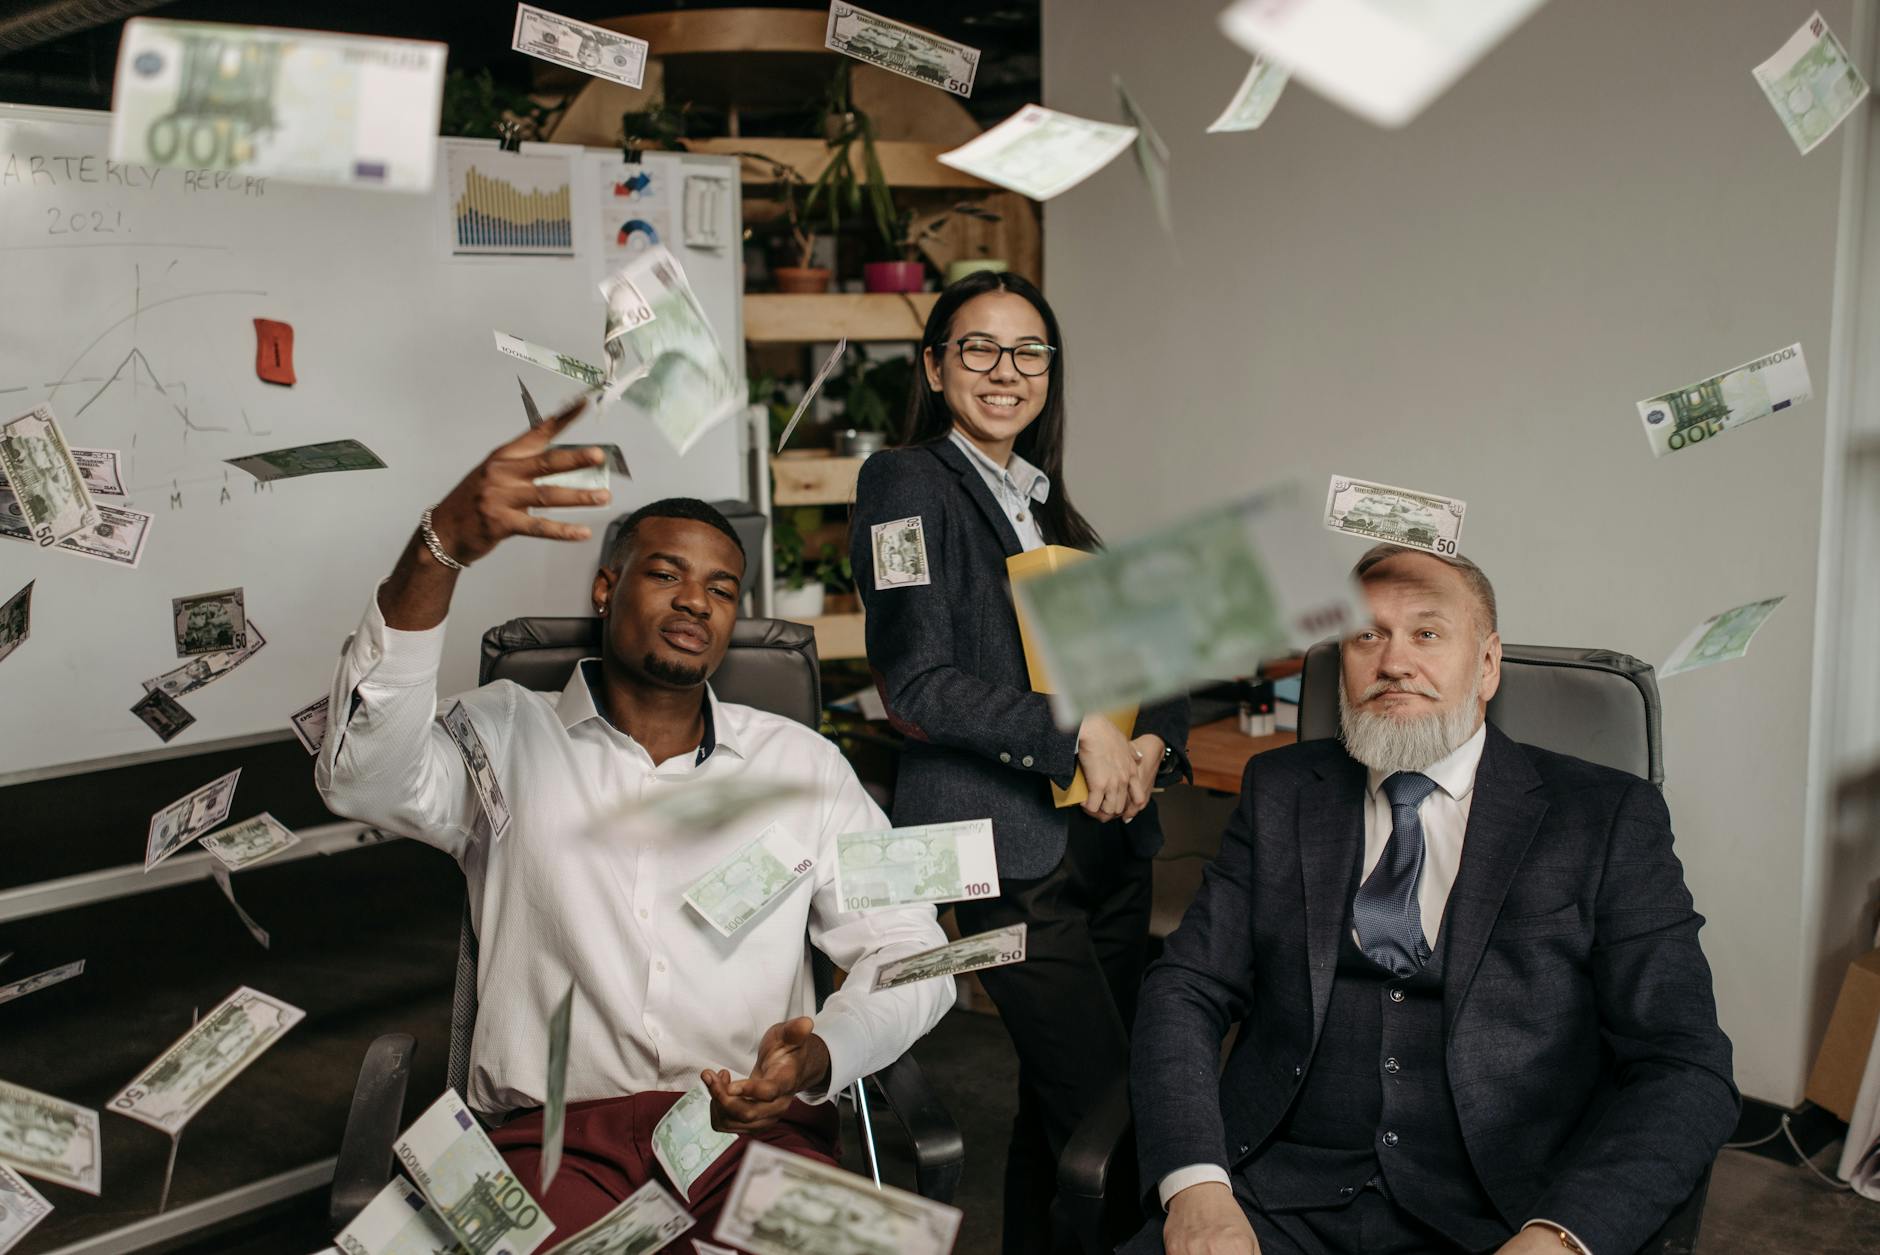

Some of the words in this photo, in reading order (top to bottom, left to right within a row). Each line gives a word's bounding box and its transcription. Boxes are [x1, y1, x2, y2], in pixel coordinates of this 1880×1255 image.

[949, 78, 970, 95] 50
[627, 305, 651, 325] 50
[1667, 419, 1719, 451] 100
[219, 486, 232, 507] A
[906, 517, 920, 528] 50
[34, 525, 56, 548] 50
[1436, 538, 1456, 555] 50
[235, 632, 247, 649] 50
[793, 858, 813, 875] 100
[965, 882, 991, 897] 100
[845, 896, 870, 911] 100
[1001, 950, 1023, 963] 50
[114, 1087, 146, 1110] 50
[399, 1142, 417, 1167] 100
[495, 1174, 540, 1231] 100
